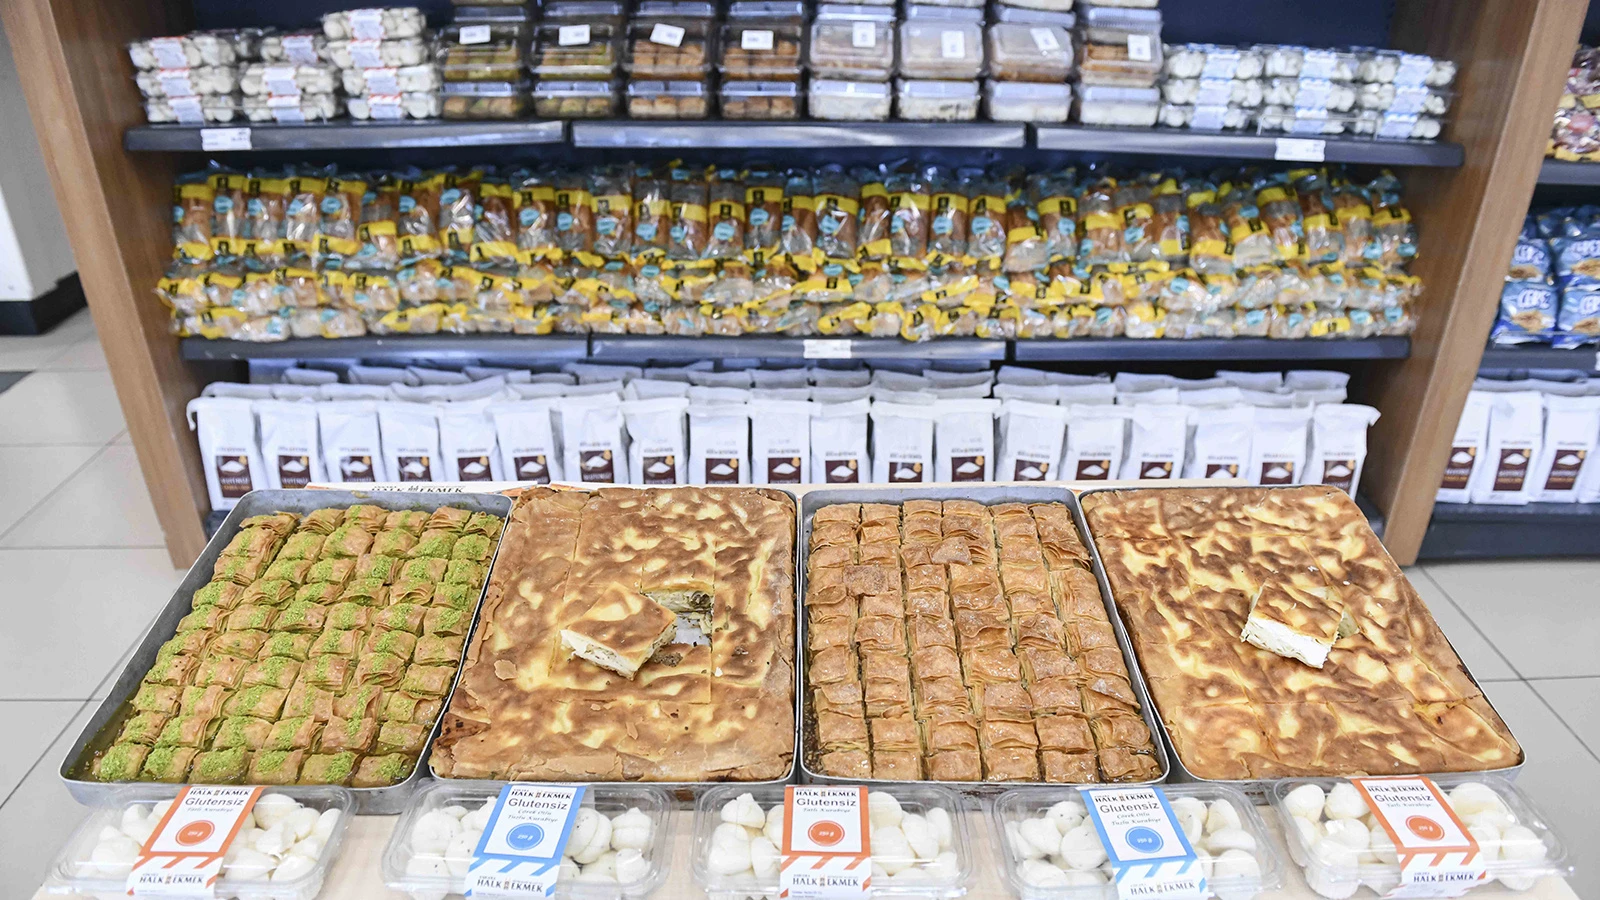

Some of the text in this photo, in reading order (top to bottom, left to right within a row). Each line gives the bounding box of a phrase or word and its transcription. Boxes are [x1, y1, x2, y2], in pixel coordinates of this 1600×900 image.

[185, 797, 245, 806] Glutensiz
[1125, 793, 1156, 801] EKMEK
[1374, 794, 1434, 803] Glutensiz
[508, 798, 568, 810] Glutensiz
[796, 798, 857, 807] Glutensiz
[1100, 801, 1160, 814] Glutensiz
[792, 878, 859, 887] HALK EKMEK
[1413, 875, 1437, 883] HALK
[1445, 874, 1475, 882] EKMEK
[476, 879, 502, 888] HALK
[511, 881, 543, 892] EKMEK
[1130, 882, 1196, 896] HALK EKMEK
